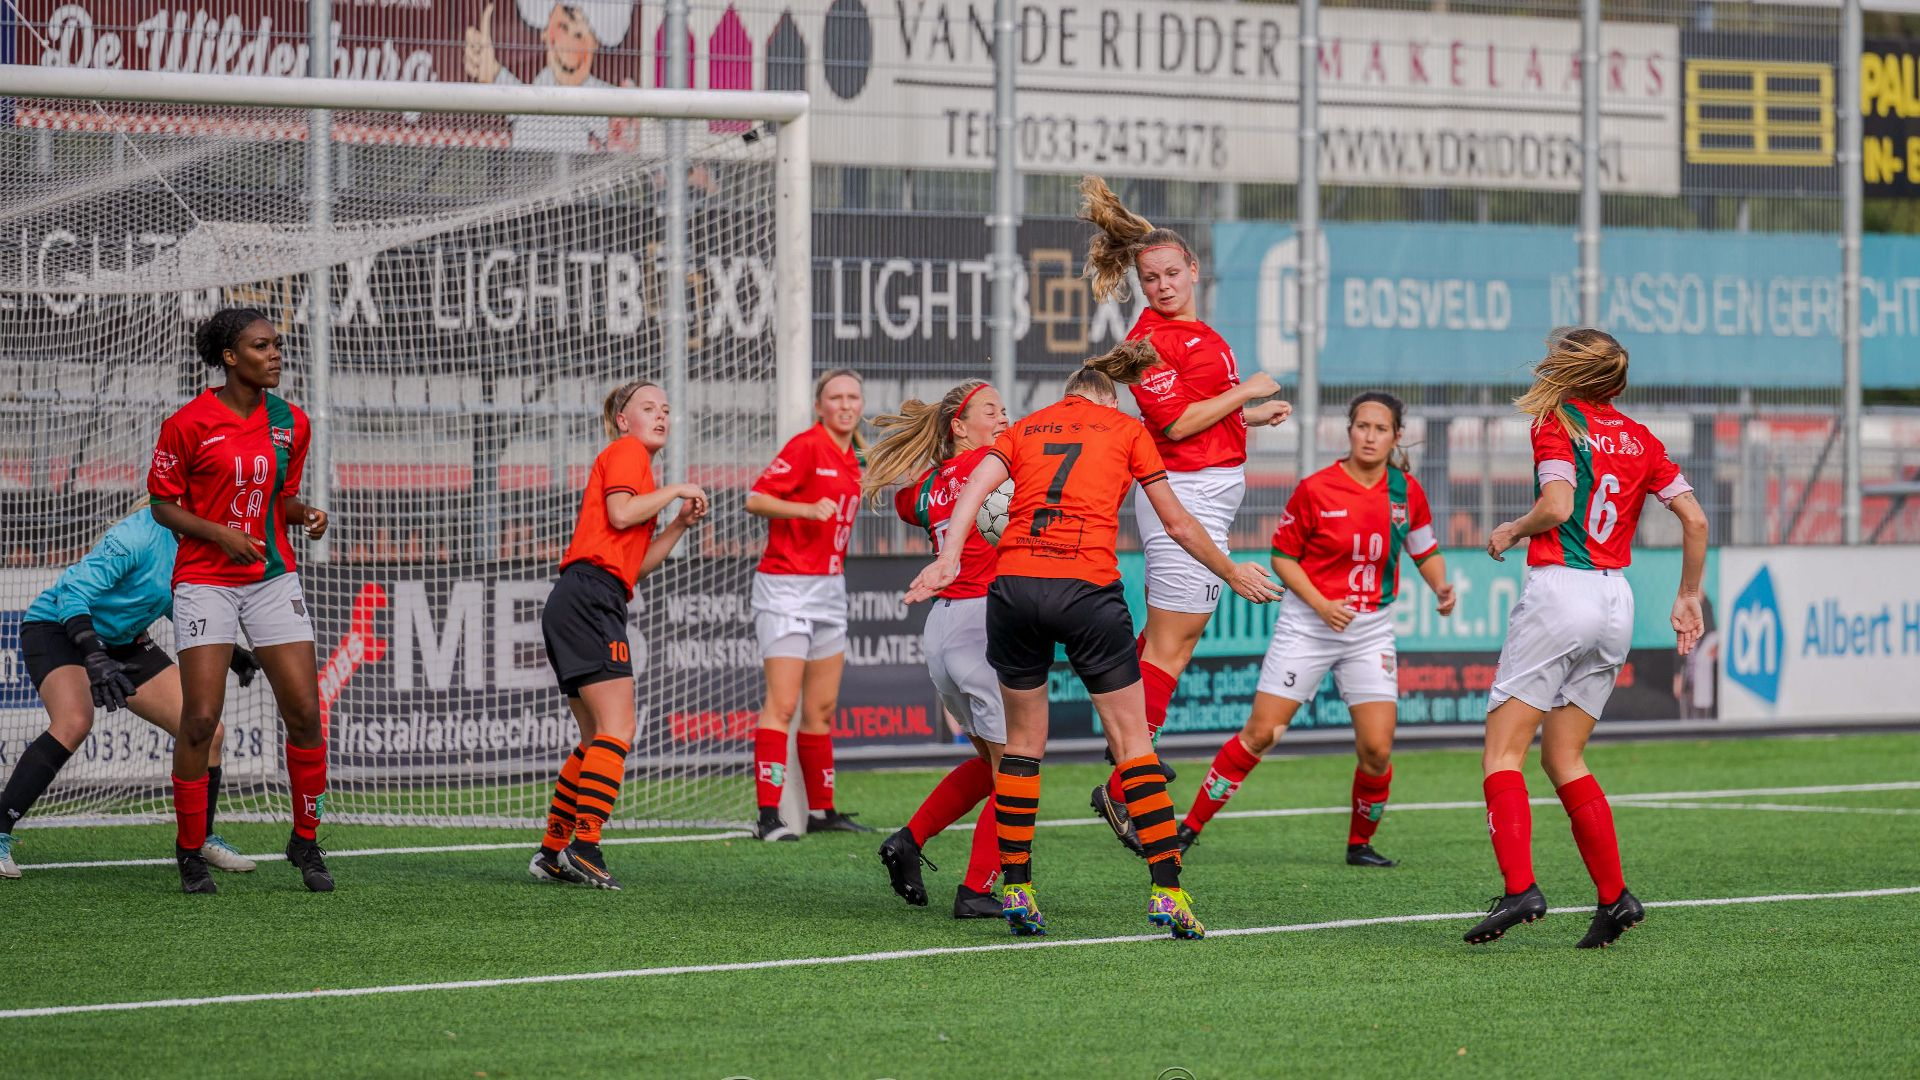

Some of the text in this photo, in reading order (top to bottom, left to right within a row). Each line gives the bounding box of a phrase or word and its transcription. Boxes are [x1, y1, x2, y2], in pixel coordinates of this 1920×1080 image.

[41, 4, 124, 69] De
[897, 0, 1281, 78] VAN DE RIDDER
[1860, 52, 1920, 118] PAL
[1344, 277, 1512, 330] BOSVELD
[1551, 272, 1920, 338] INASSO EN GERCHT
[1024, 422, 1062, 436] Ekris
[1579, 433, 1616, 454] NG
[1043, 443, 1083, 504] 7
[1588, 473, 1620, 544] 6
[1205, 585, 1219, 601] 10
[189, 619, 207, 637] 37
[609, 641, 630, 663] 10
[1801, 599, 1892, 658] Albert
[1283, 671, 1297, 688] 3
[339, 705, 580, 753] Installatietechnie
